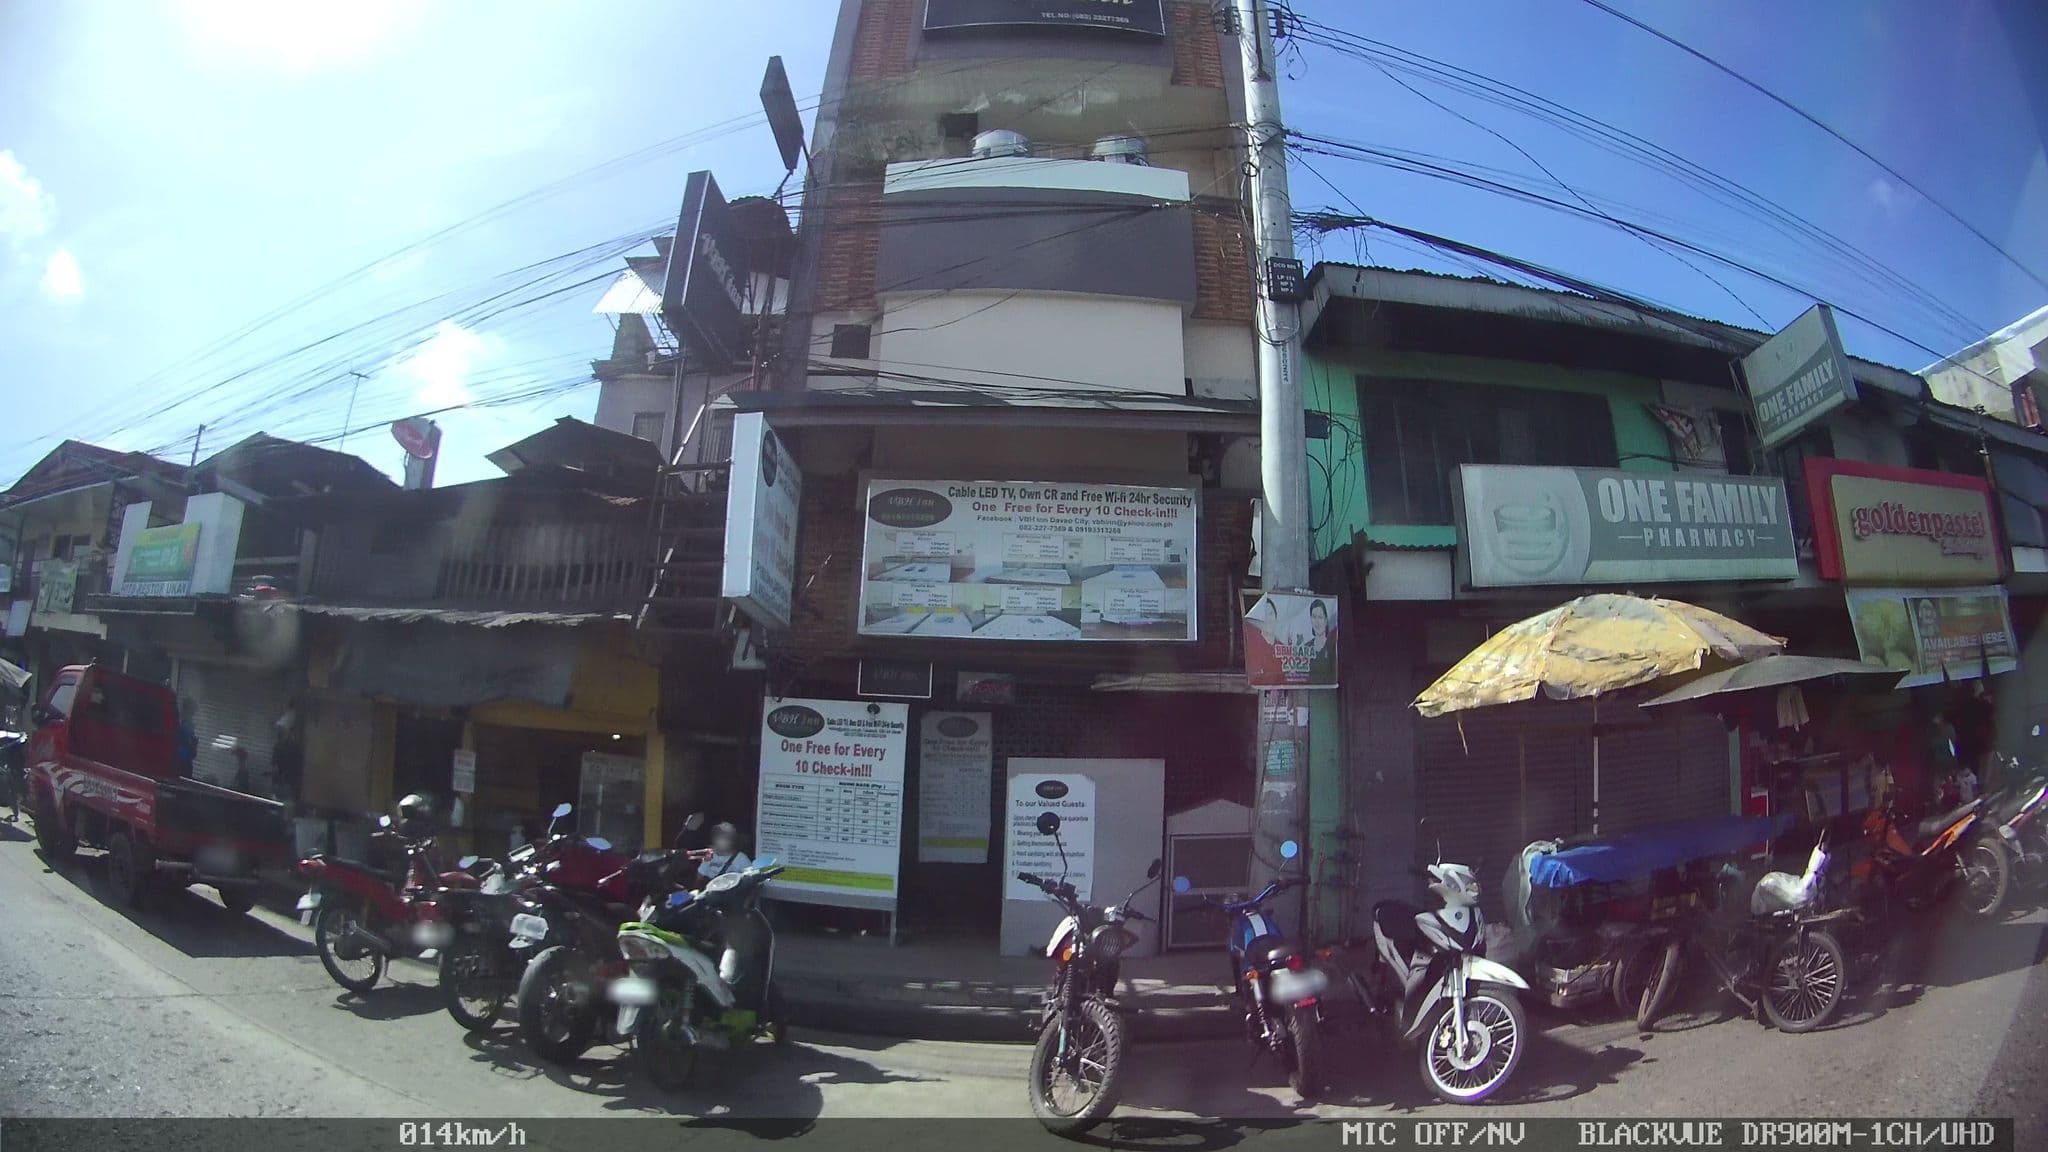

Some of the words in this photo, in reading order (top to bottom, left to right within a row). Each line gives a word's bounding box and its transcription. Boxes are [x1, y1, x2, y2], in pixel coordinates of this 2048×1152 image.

[1758, 391, 1787, 422] ONE
[1786, 358, 1834, 406] FAMILY
[1776, 390, 1824, 426] PHARMACY
[948, 486, 976, 498] Cable
[979, 487, 998, 499] LED
[1001, 488, 1016, 500] TV,
[1019, 488, 1041, 500] Own
[1044, 489, 1058, 500] CR
[1060, 490, 1078, 502] and
[1081, 490, 1102, 502] Free
[1129, 492, 1150, 504] 24hr
[1153, 493, 1192, 508] Security
[1597, 477, 1672, 523] ONE
[1675, 480, 1778, 525] FAMILY
[972, 501, 997, 512] One
[1004, 502, 1032, 513] Free
[1036, 503, 1053, 514] for
[1056, 504, 1091, 517] Every
[1097, 505, 1110, 516] 10
[1114, 506, 1178, 519] Check-in!!!
[1050, 517, 1072, 525] Davao
[1855, 501, 1987, 541] goldenpastel
[1643, 527, 1756, 548] PHARMACY
[1924, 633, 1979, 649] AVAILABLE
[1282, 656, 1310, 672] 2022
[781, 739, 802, 752] One
[806, 741, 830, 755] Free
[834, 742, 850, 756] for
[853, 744, 886, 761] Every
[795, 760, 808, 773] 10
[812, 761, 872, 777] Check-in!!!
[1038, 800, 1060, 808] Valued
